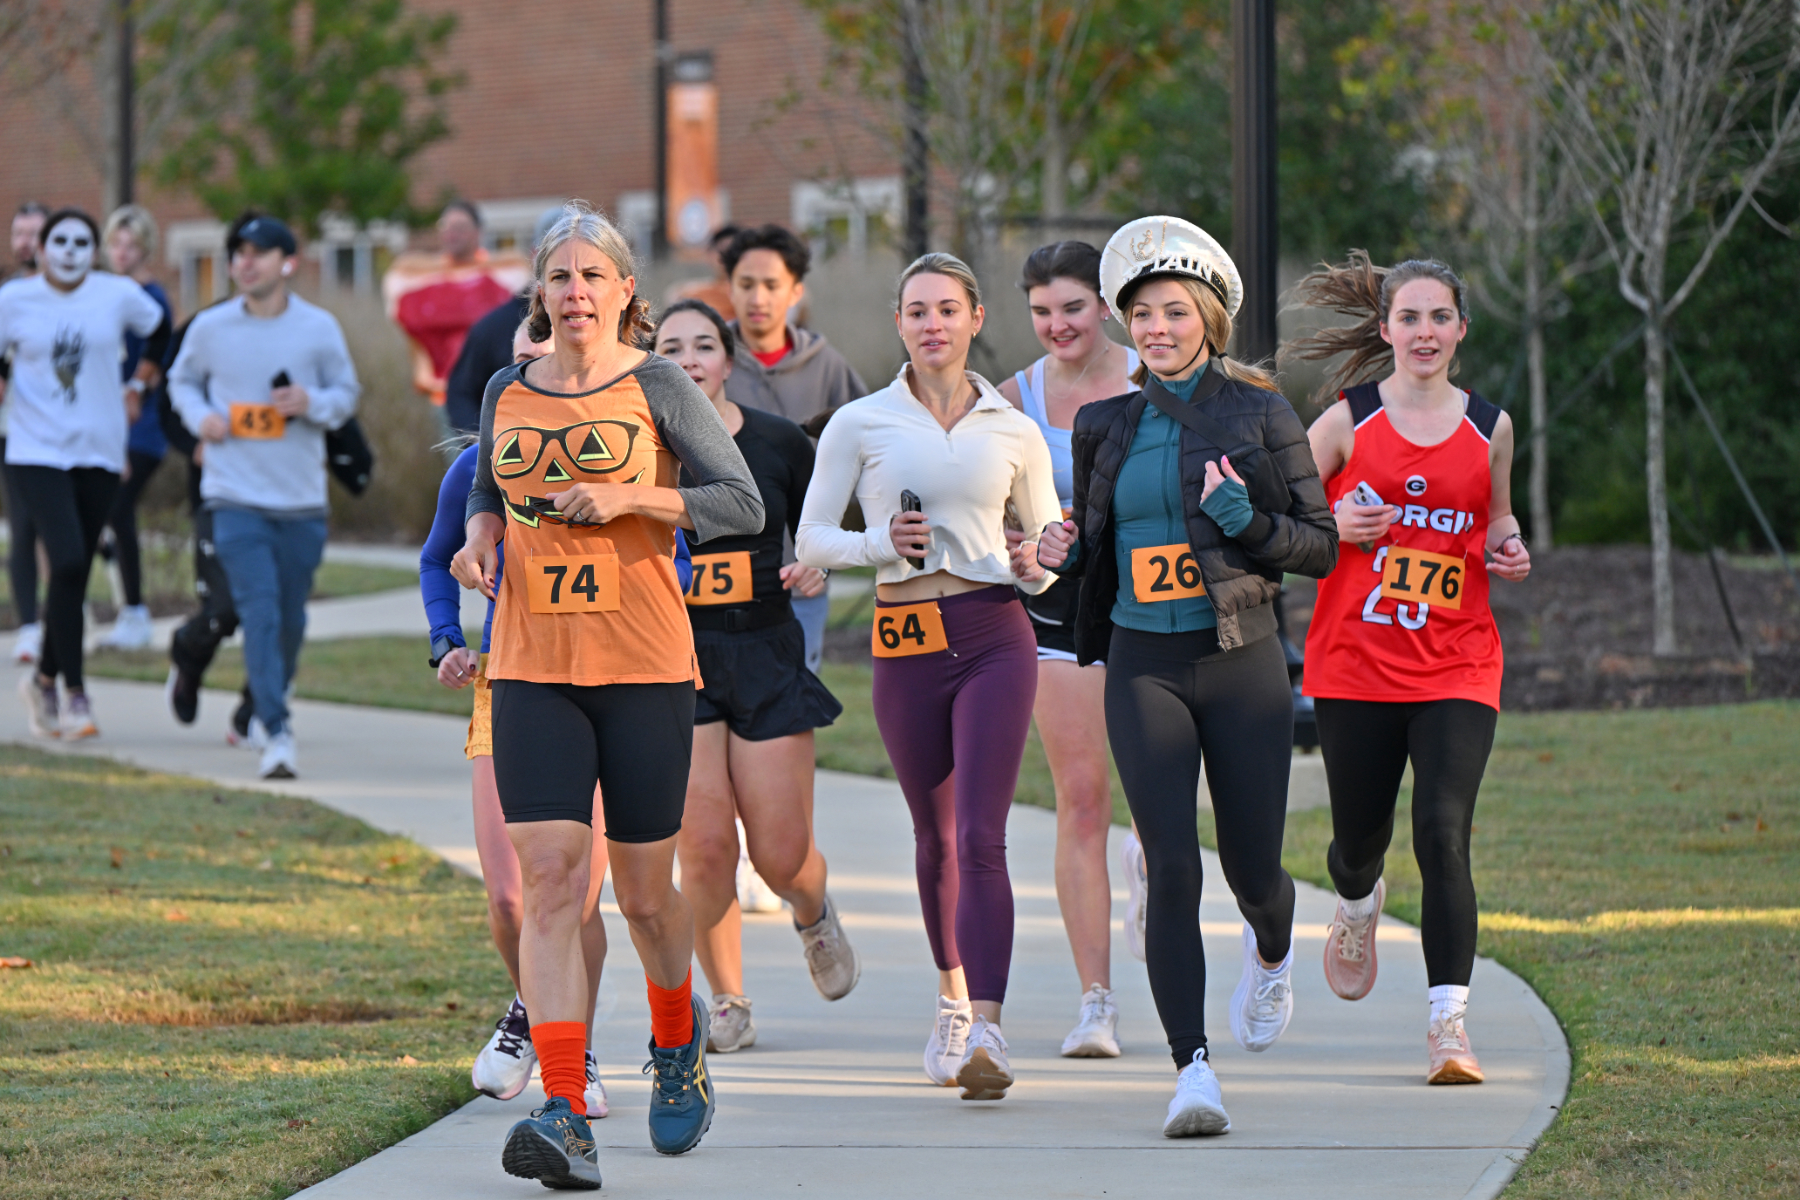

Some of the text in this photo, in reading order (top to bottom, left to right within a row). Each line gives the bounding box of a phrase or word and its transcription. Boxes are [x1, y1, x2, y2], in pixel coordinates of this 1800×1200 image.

[241, 409, 272, 431] 45
[1406, 478, 1427, 494] G
[544, 565, 599, 603] 74
[692, 562, 733, 597] 75
[1149, 552, 1201, 593] 26
[1390, 557, 1461, 600] 176
[879, 613, 926, 649] 64
